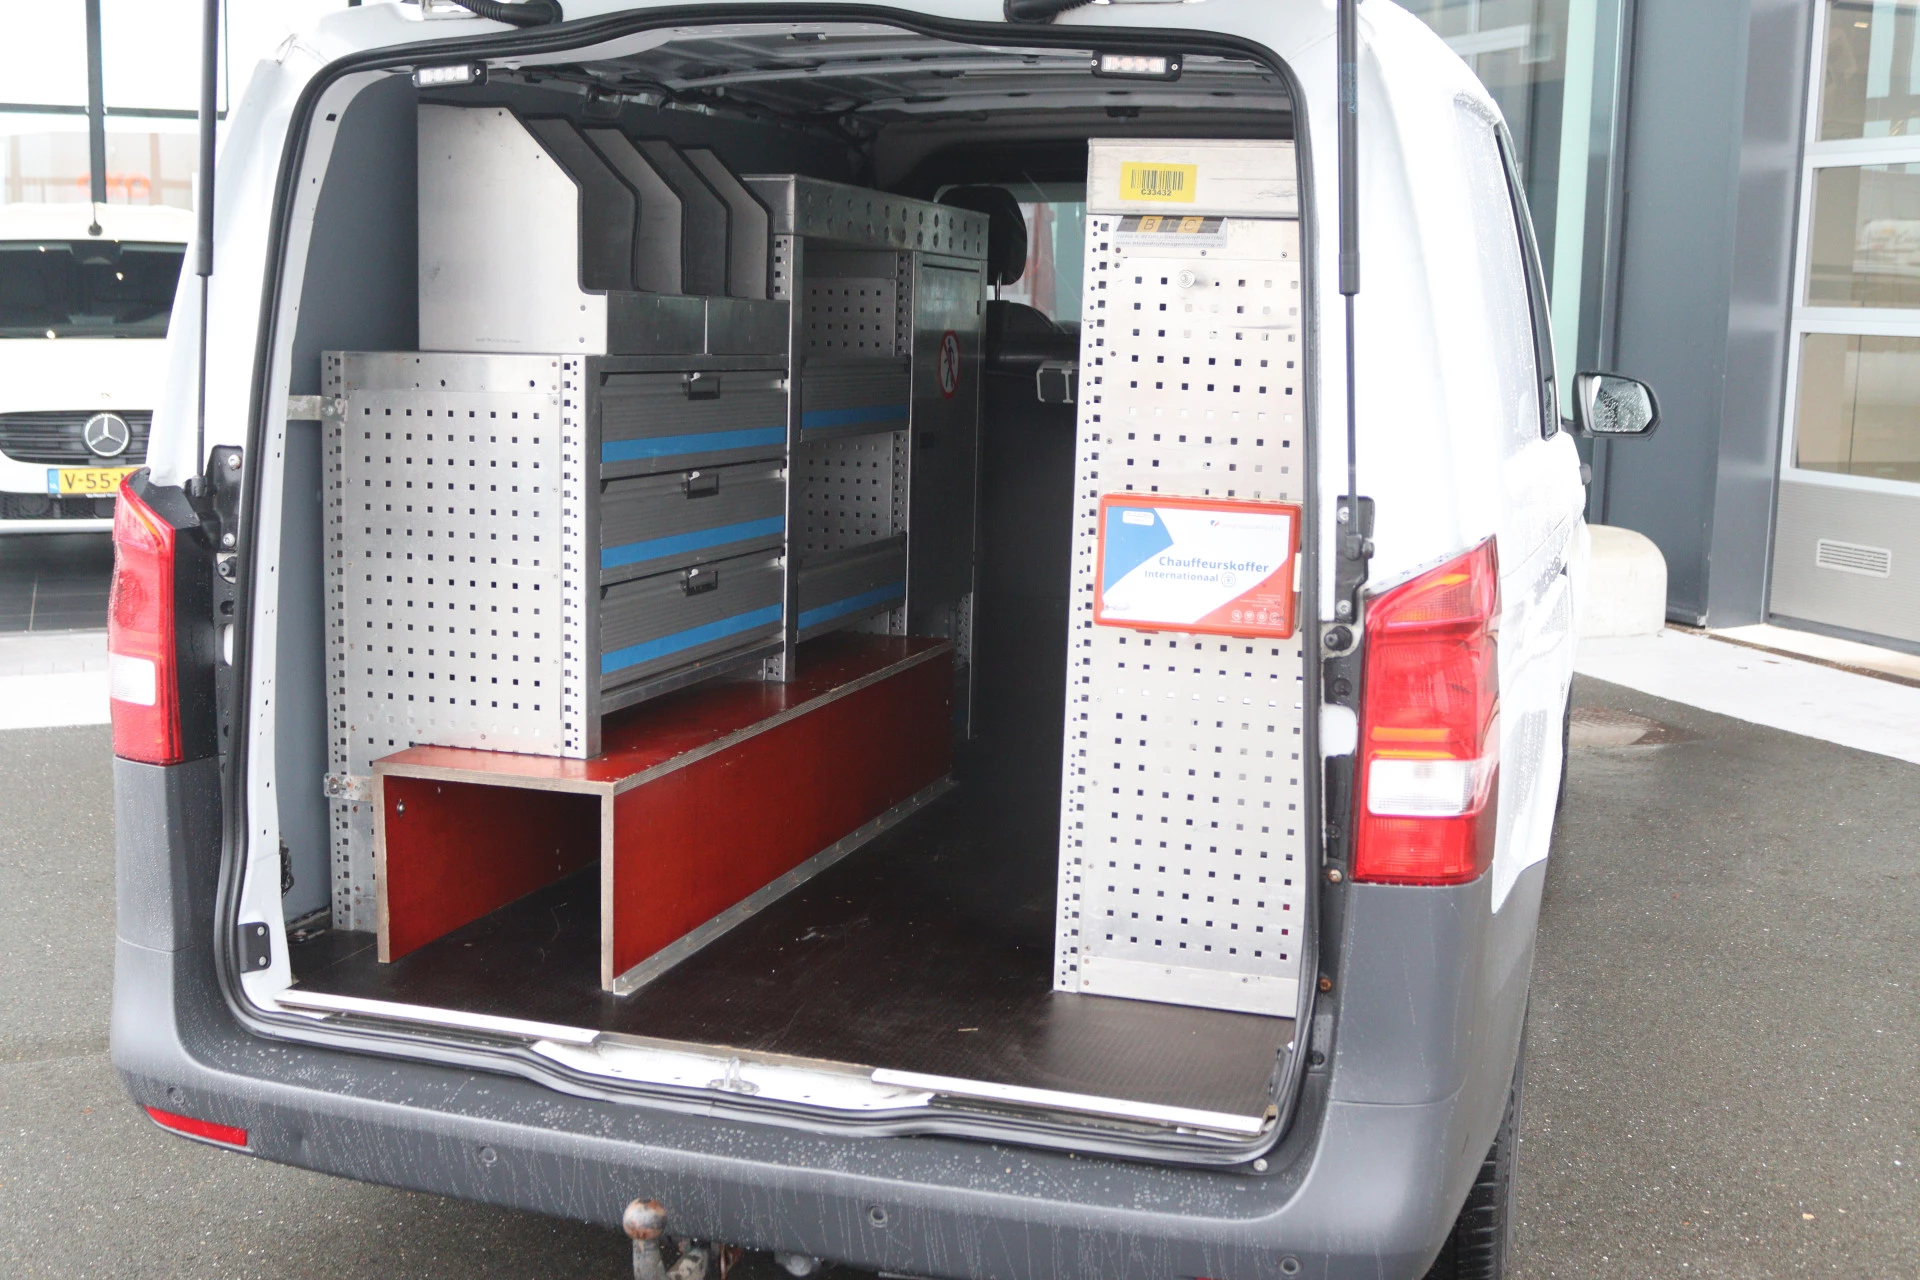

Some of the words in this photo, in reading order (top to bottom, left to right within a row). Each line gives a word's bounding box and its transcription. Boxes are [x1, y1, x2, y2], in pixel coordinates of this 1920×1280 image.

[1141, 188, 1172, 197] C33432
[64, 472, 124, 490] V-55-
[1158, 556, 1269, 573] Chauffeurskoffer
[1144, 570, 1219, 583] Internationaal
